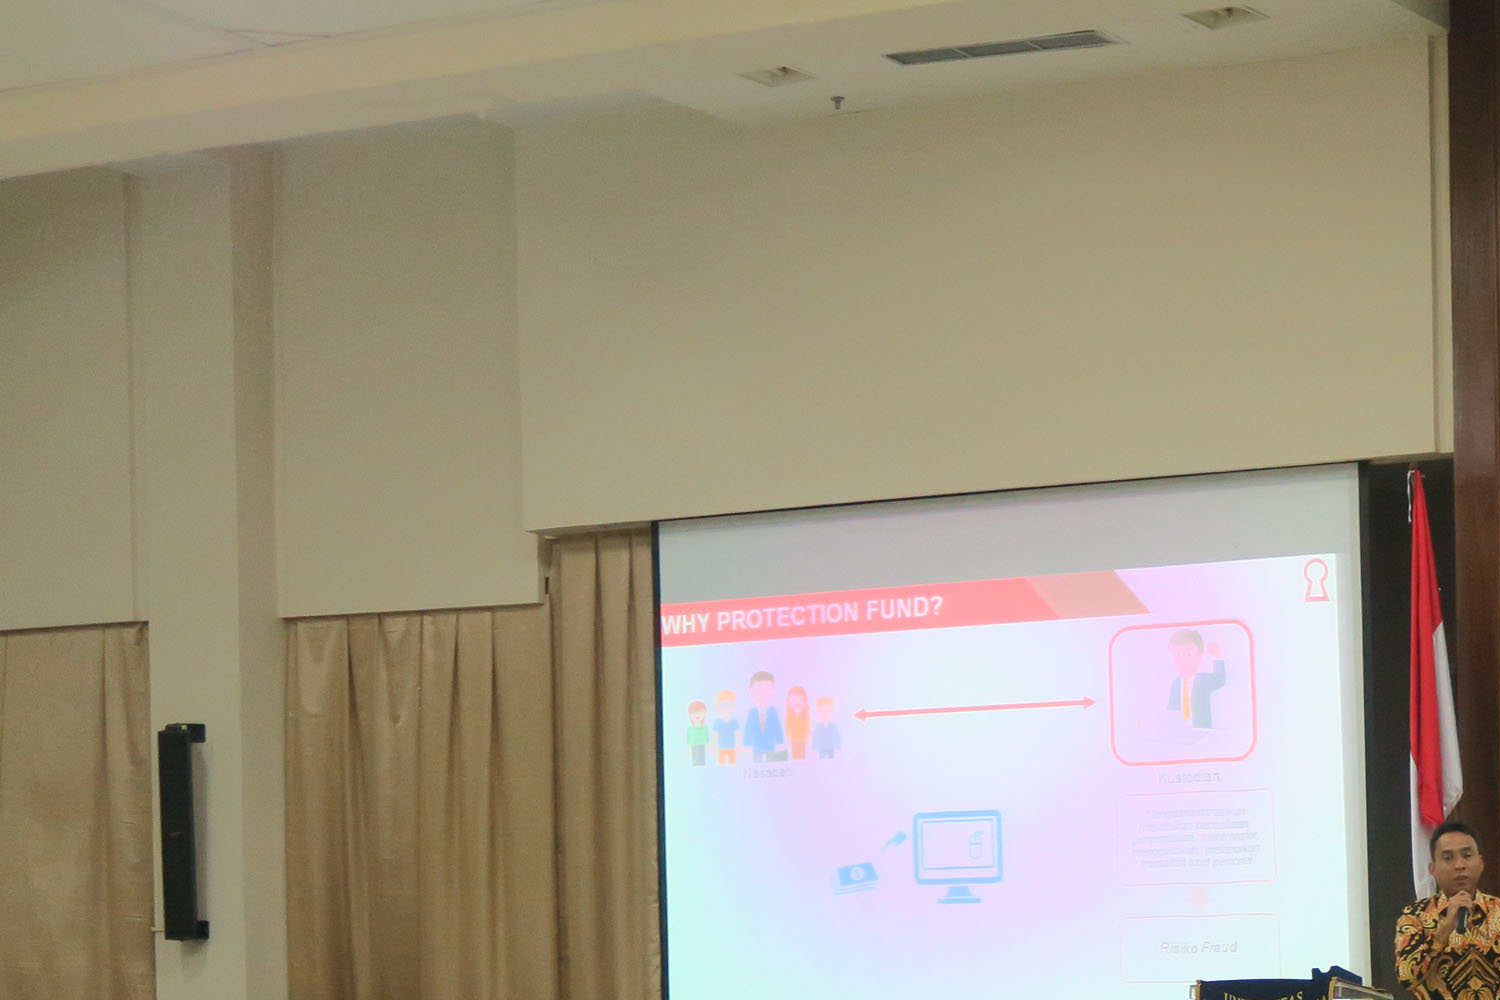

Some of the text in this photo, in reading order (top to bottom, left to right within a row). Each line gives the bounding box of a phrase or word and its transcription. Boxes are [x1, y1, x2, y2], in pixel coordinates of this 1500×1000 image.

[661, 594, 944, 636] WHY PROTECTION FUND?
[1159, 939, 1238, 955] Risiko Fraud
